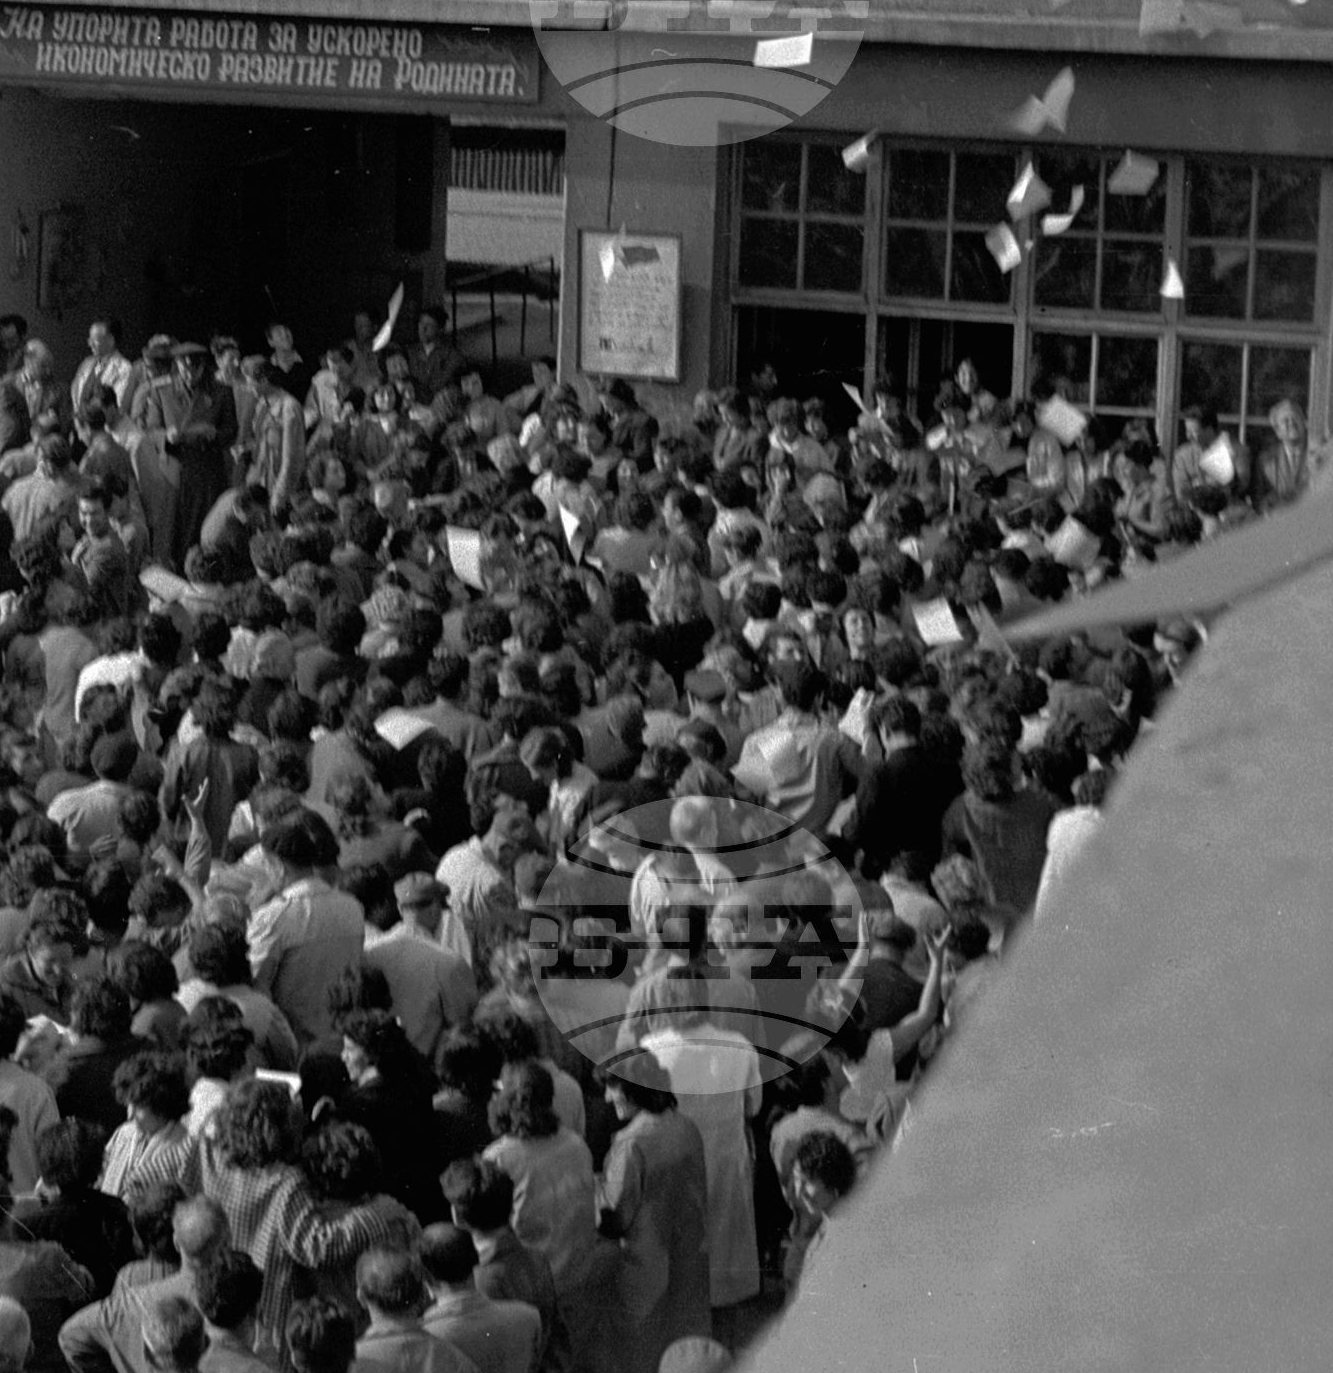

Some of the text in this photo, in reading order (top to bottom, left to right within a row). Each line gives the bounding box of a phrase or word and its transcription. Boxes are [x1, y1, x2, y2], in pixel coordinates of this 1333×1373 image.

[52, 11, 161, 46] УПОРИТА
[169, 16, 258, 51] РАБОТА
[268, 22, 297, 53] ЗА
[307, 24, 423, 59] УСКОРЕНО
[36, 42, 211, 78] ИКОНОМИЧЕСКО
[218, 51, 340, 87] РАЗВИТИЕ
[349, 58, 382, 90] НА
